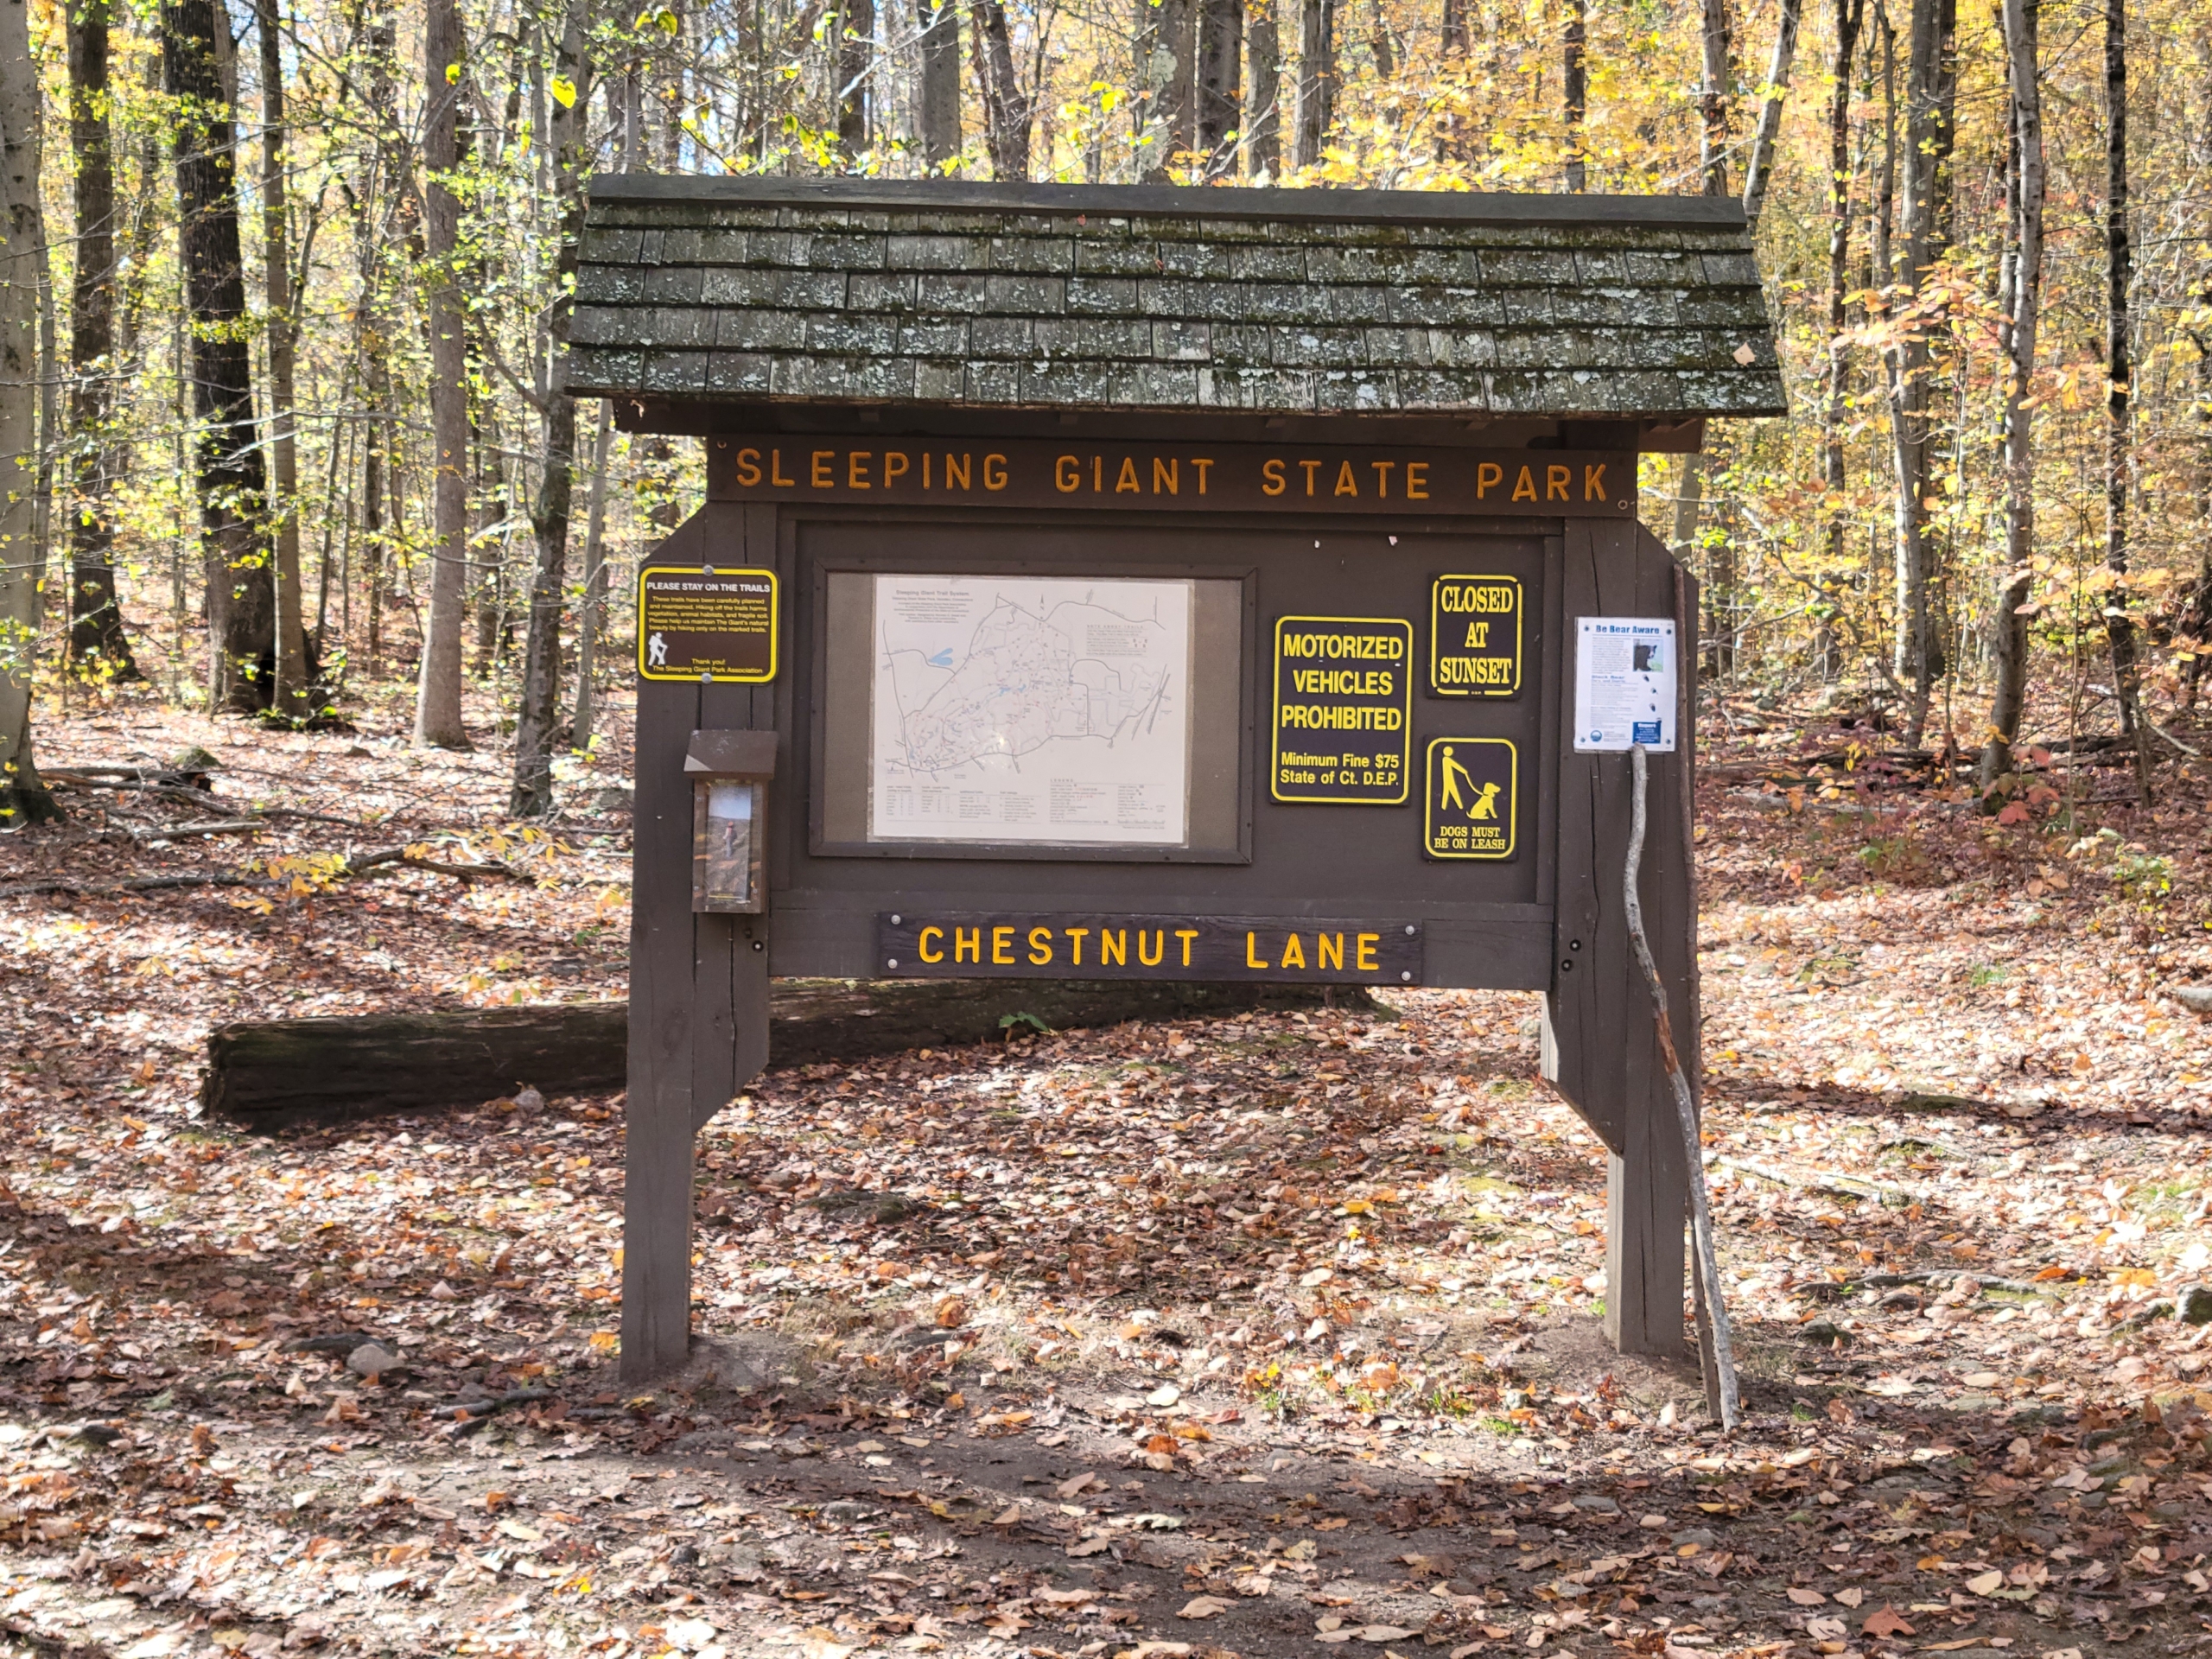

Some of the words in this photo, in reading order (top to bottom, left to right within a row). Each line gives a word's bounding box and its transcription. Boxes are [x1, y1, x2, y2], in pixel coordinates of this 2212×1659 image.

[735, 448, 1008, 492] SLEEPING
[1055, 454, 1214, 496] GIANT
[1262, 459, 1430, 499] STATE
[1477, 462, 1607, 502] PARK
[682, 582, 702, 591] STAY
[740, 584, 770, 593] TRAILS
[1441, 586, 1513, 613] CLOSED
[1465, 622, 1489, 648] AT
[1632, 626, 1659, 634] Aware
[1284, 634, 1403, 659] MOTORIZED
[1293, 670, 1393, 695] VEHICLES
[1440, 657, 1512, 683] SUNSET
[1281, 705, 1402, 731] PROHIBITED
[1281, 752, 1338, 766] Minimum
[1343, 753, 1370, 767] Fine
[1375, 753, 1399, 769] $75
[1281, 769, 1315, 784] State
[1320, 770, 1335, 785] of
[1339, 771, 1357, 785] Ct.
[1363, 772, 1399, 785] D.E.P.
[1434, 838, 1448, 849] BE
[1452, 838, 1467, 849] ON
[1471, 839, 1505, 849] LEASH
[1440, 826, 1467, 836] DOGS
[1471, 827, 1501, 837] MUST
[918, 925, 1199, 967] CHESTNUT
[1246, 931, 1381, 971] LANE
